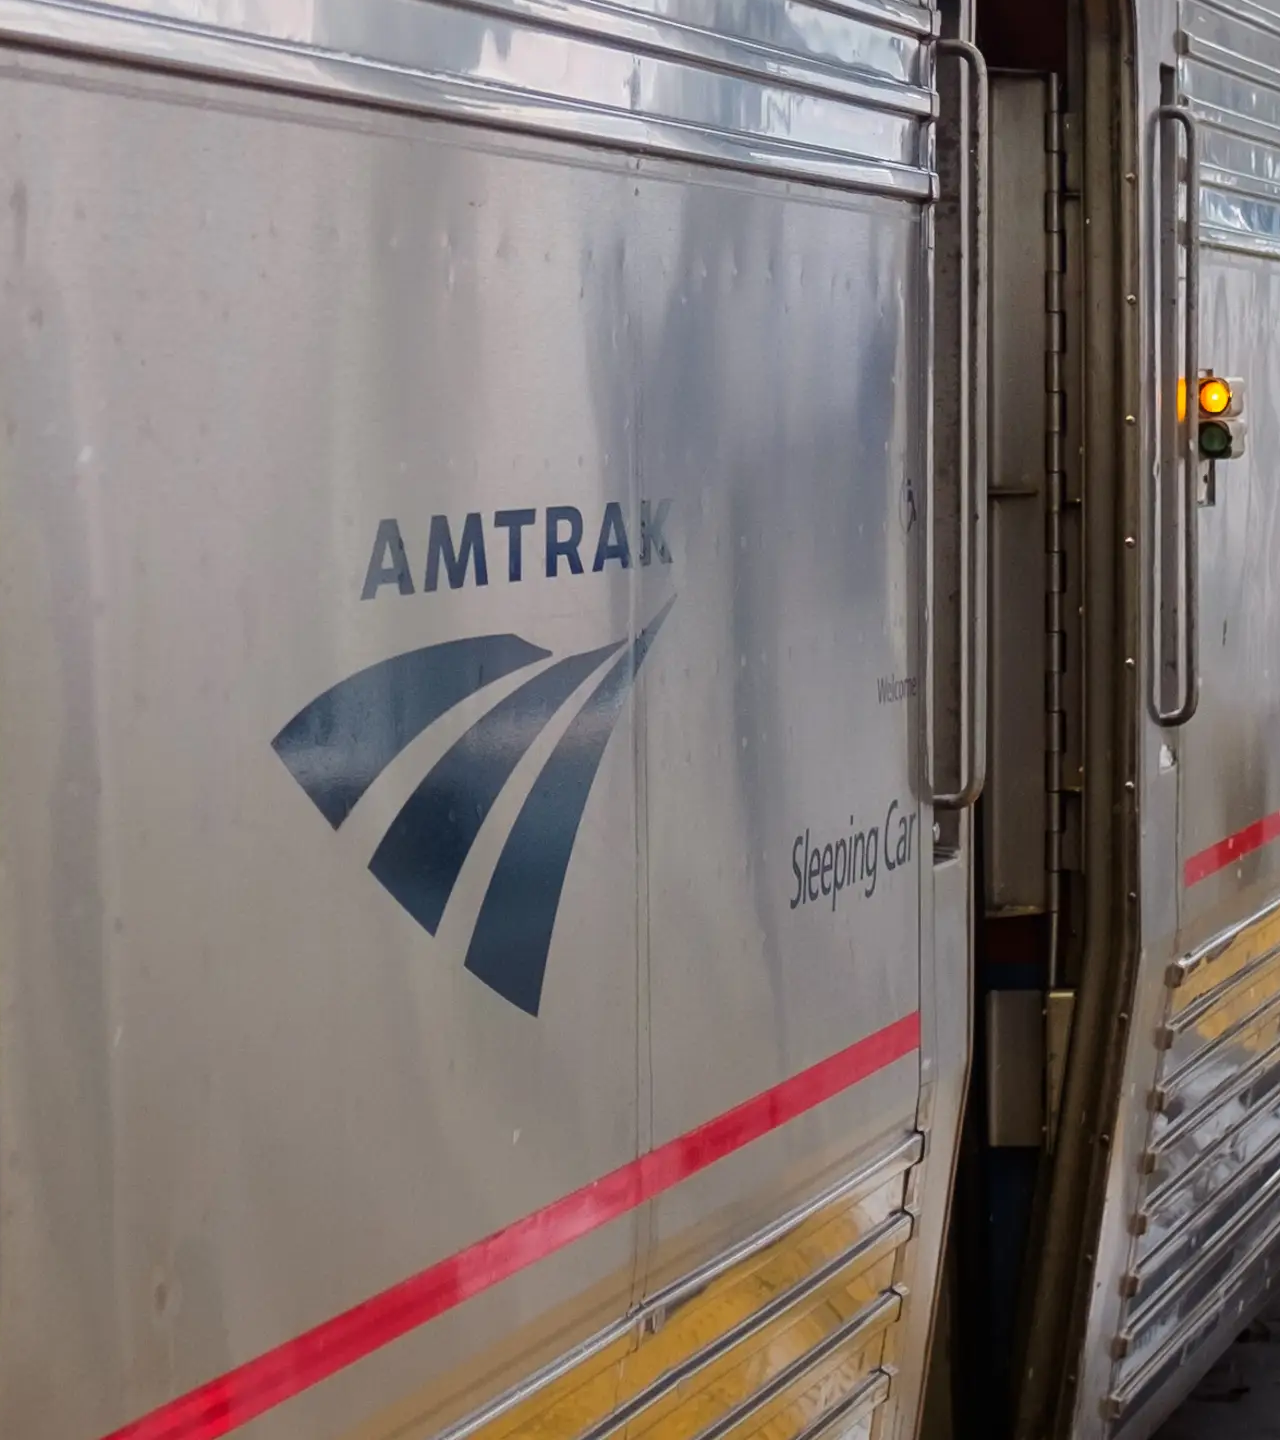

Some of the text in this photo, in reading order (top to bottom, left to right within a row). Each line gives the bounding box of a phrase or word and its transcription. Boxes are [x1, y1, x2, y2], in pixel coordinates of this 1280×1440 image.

[360, 498, 674, 601] AMTRAK
[877, 673, 918, 704] Welcome
[790, 799, 917, 912] Sleeping Car
